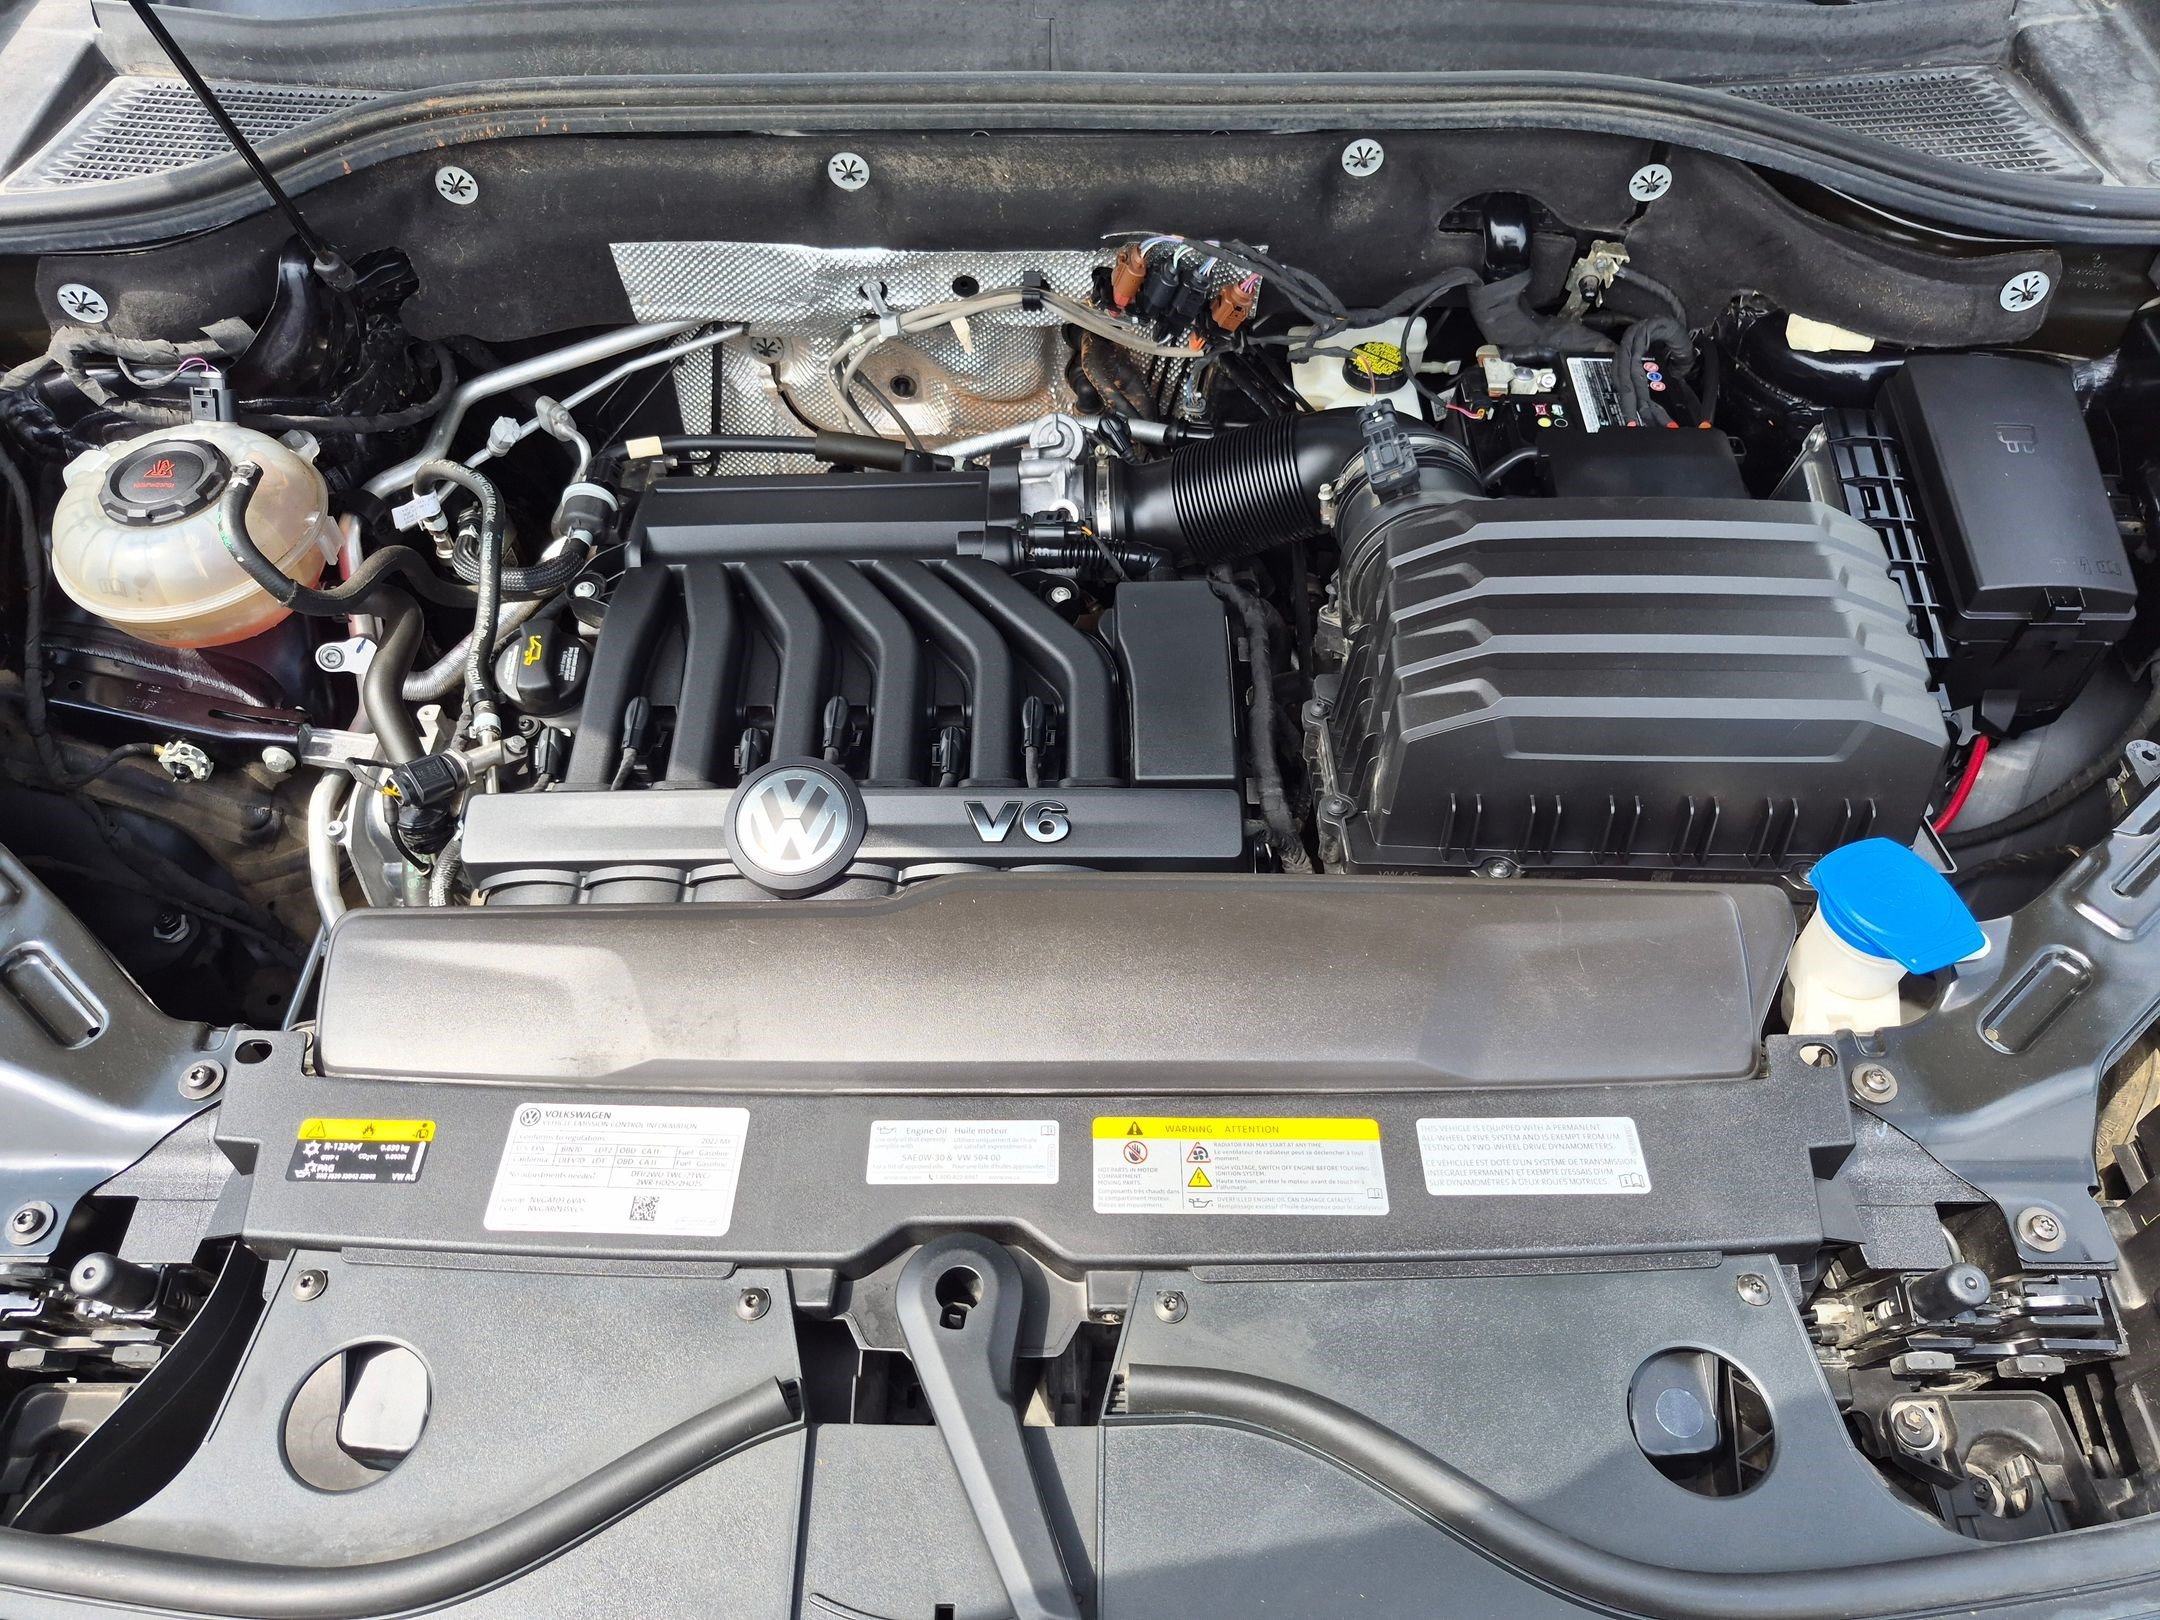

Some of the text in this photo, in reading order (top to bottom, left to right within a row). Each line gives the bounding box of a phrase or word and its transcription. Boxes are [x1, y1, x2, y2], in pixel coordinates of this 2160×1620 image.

[963, 800, 1071, 843] V6
[545, 1110, 612, 1119] VOLKSWAGEN
[906, 1127, 1008, 1136] Engine Oil Huile moteur
[1165, 1125, 1280, 1134] WARNING ATTENTION
[1473, 1124, 1480, 1132] IS
[1481, 1124, 1520, 1132] EQUIPPED
[1522, 1133, 1540, 1141] AND
[1542, 1133, 1549, 1141] IS
[1550, 1133, 1580, 1141] EXEMPT
[1423, 1143, 1456, 1151] TESTING
[1457, 1143, 1471, 1151] ON
[946, 1153, 953, 1161] &
[956, 1153, 971, 1161] VW
[1425, 1159, 1437, 1167] CE
[1476, 1158, 1489, 1166] EST
[1516, 1168, 1526, 1176] ET
[1527, 1168, 1559, 1176] EXEMPTE
[392, 1173, 405, 1181] VW
